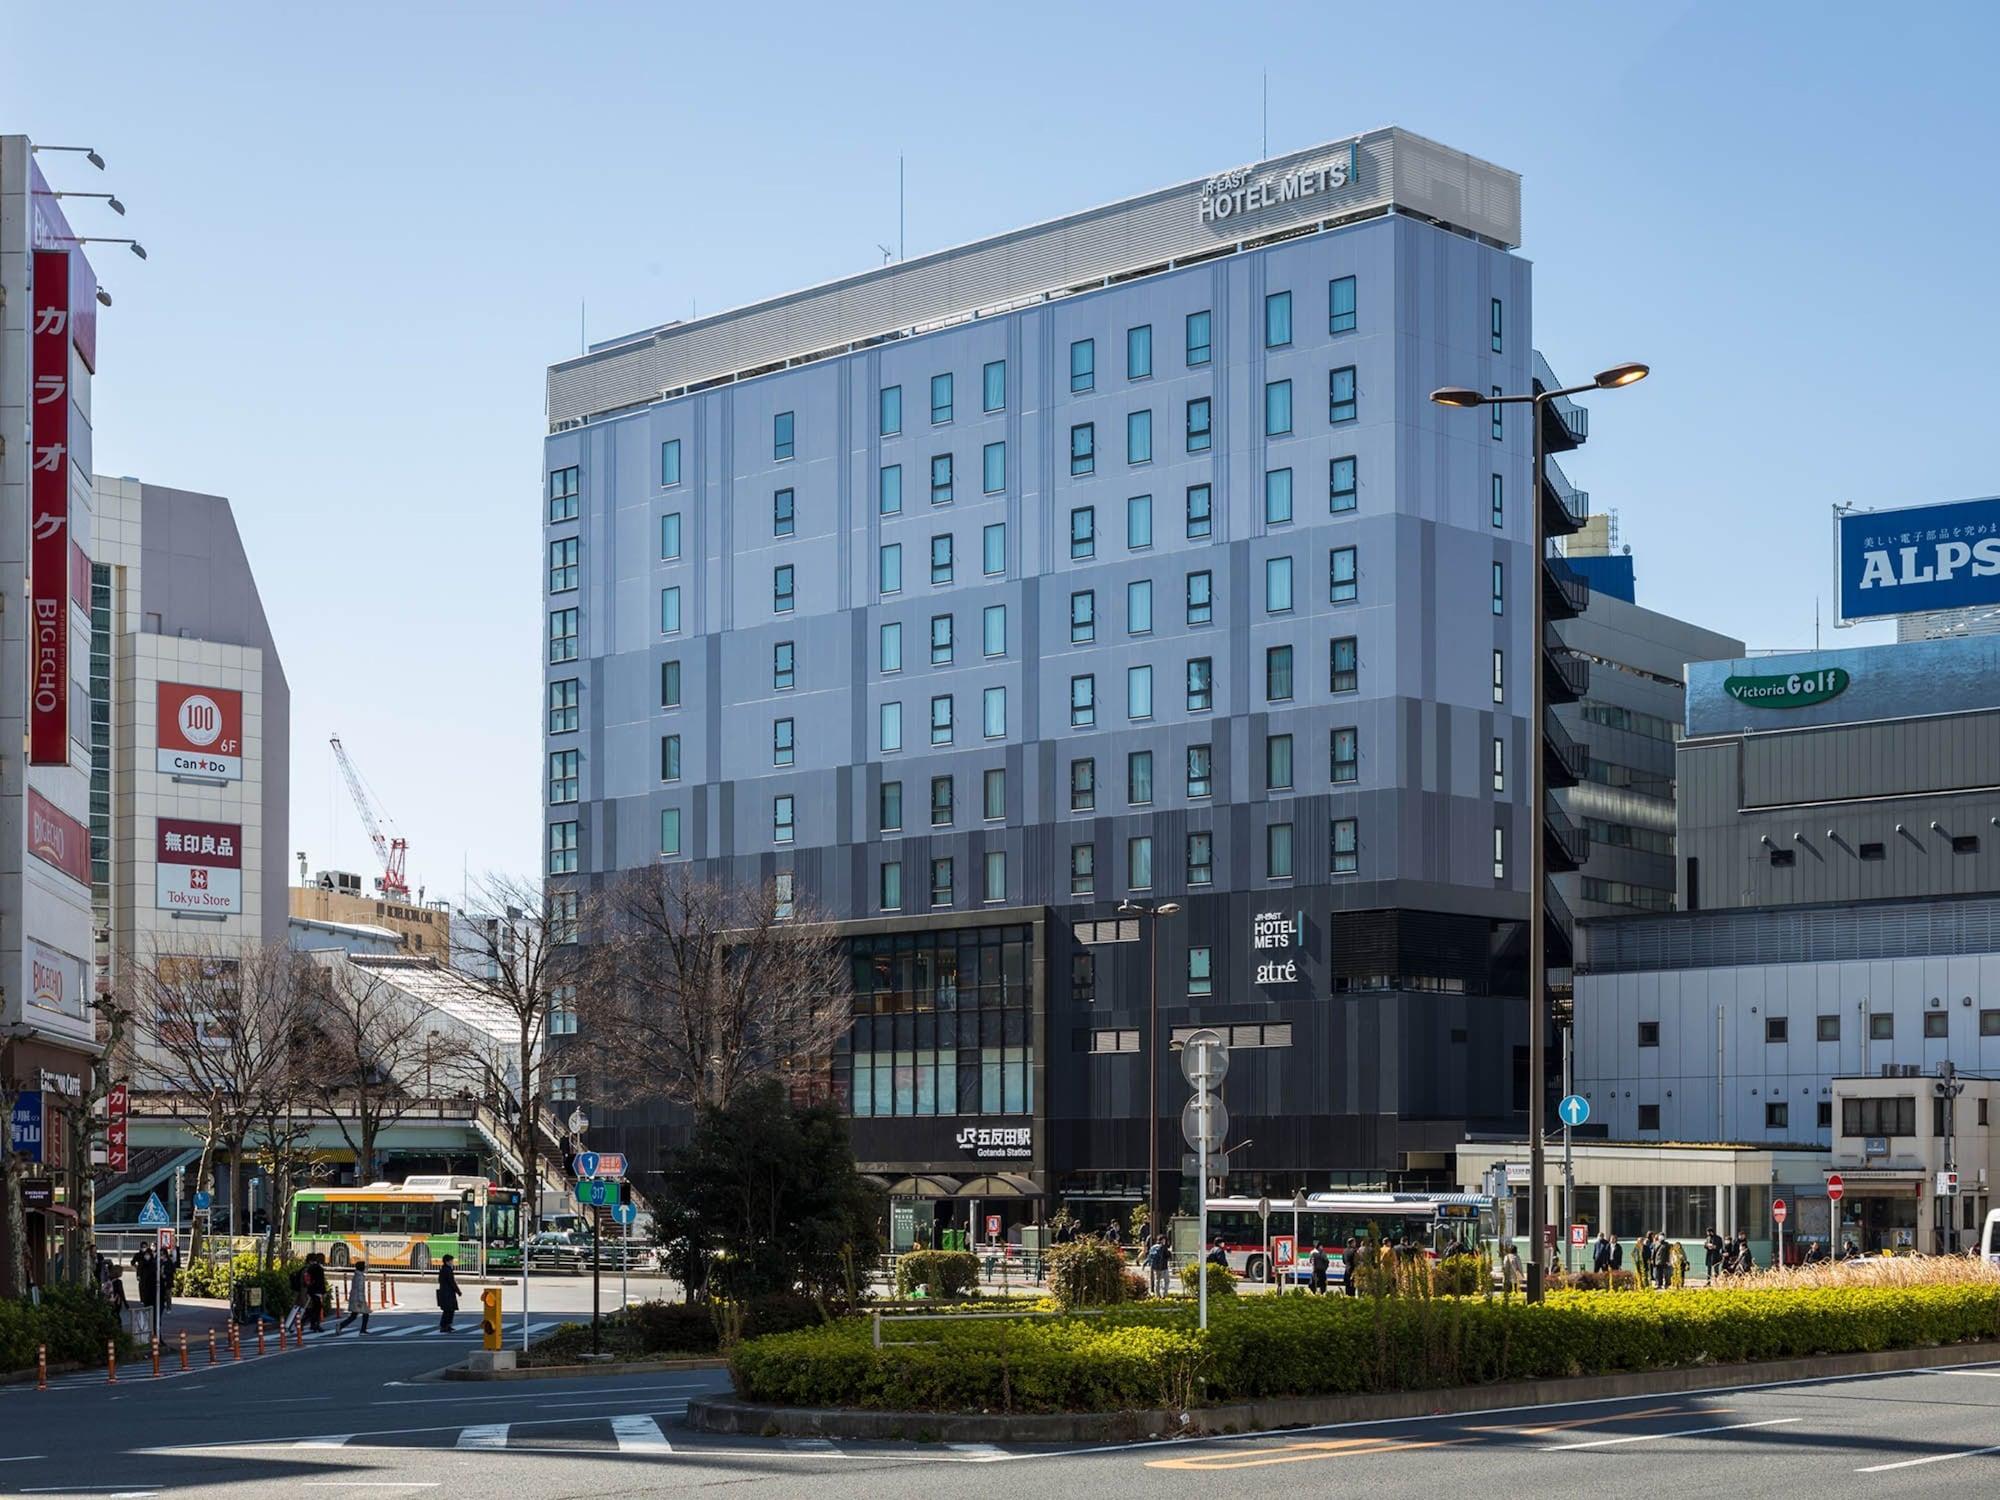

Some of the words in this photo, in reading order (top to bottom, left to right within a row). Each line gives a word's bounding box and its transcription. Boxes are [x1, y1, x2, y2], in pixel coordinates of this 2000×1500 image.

[1200, 171, 1249, 197] JR-EAST
[1200, 181, 1276, 222] HOTEL
[1280, 162, 1346, 202] METS
[33, 306, 67, 540] カラオケ
[1859, 537, 2000, 589] ALPS
[35, 598, 58, 642] BIG
[35, 647, 57, 713] ECHO
[1732, 684, 1785, 698] Victoria
[1787, 671, 1836, 695] Golf
[187, 704, 213, 732] 100
[221, 739, 238, 753] 6F
[165, 831, 234, 857] 無印良品
[168, 890, 201, 907] Tokyu
[203, 893, 231, 906] Store
[1255, 920, 1297, 935] HOTEL
[1255, 934, 1289, 949] METS
[1256, 960, 1297, 983] atré
[110, 1091, 125, 1166] カラオケ
[587, 1156, 593, 1169] 1
[977, 1148, 1006, 1157] Gotanda
[1007, 1148, 1032, 1157] Station
[592, 1186, 604, 1200] 317
